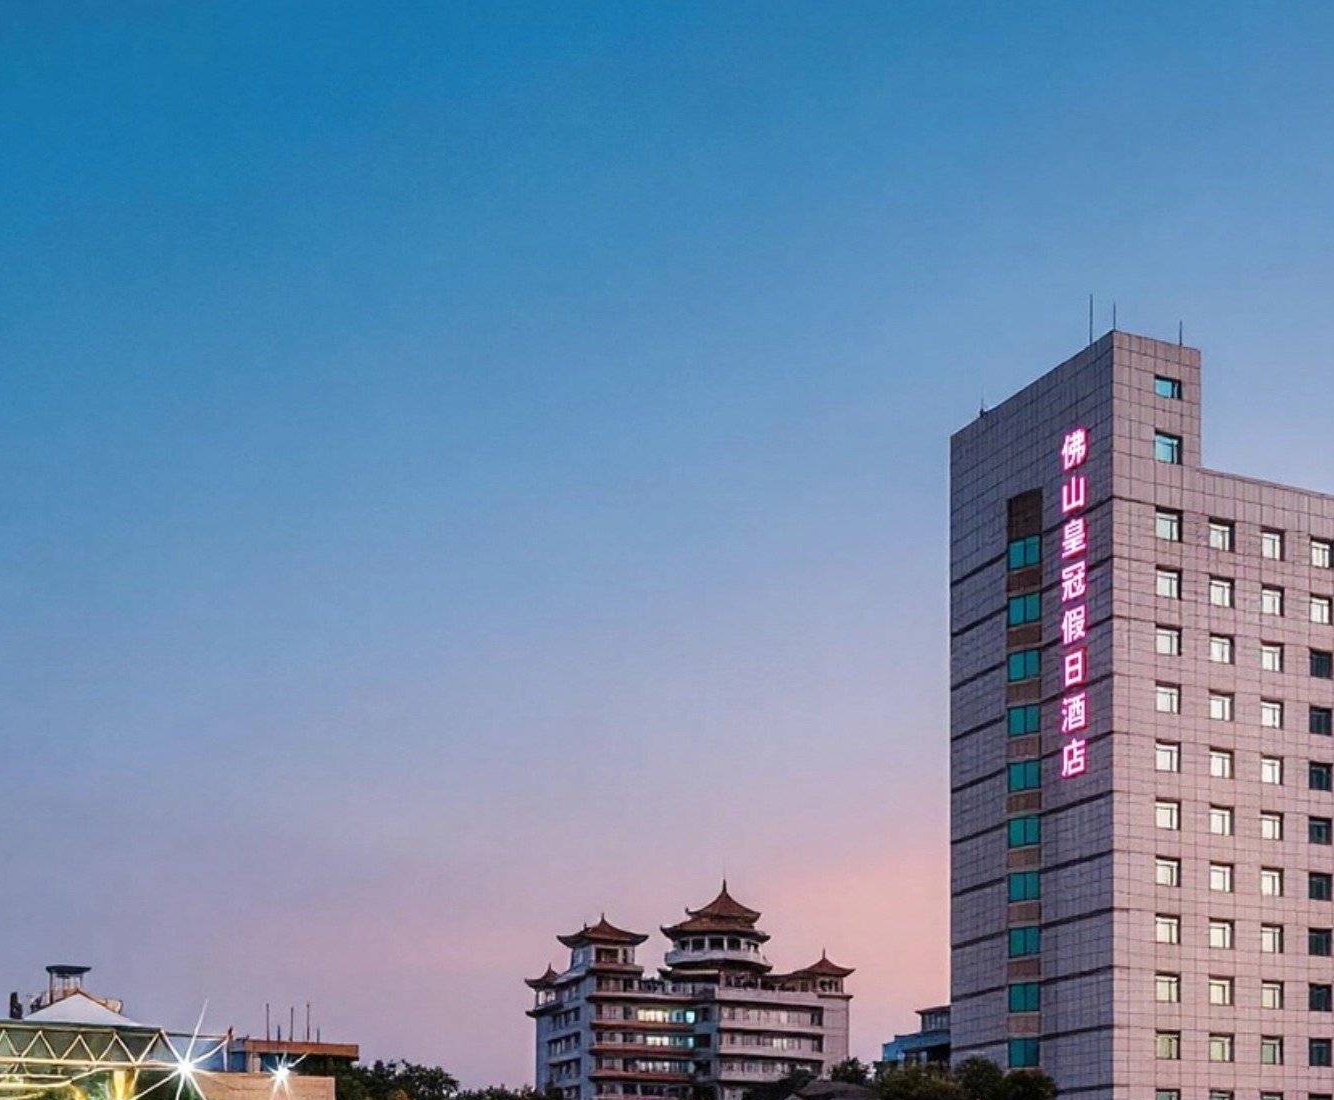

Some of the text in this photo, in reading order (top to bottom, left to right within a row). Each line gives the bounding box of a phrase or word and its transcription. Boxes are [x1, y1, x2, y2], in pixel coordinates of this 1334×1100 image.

[1060, 427, 1087, 778] 佛山皇冠假日酒店
